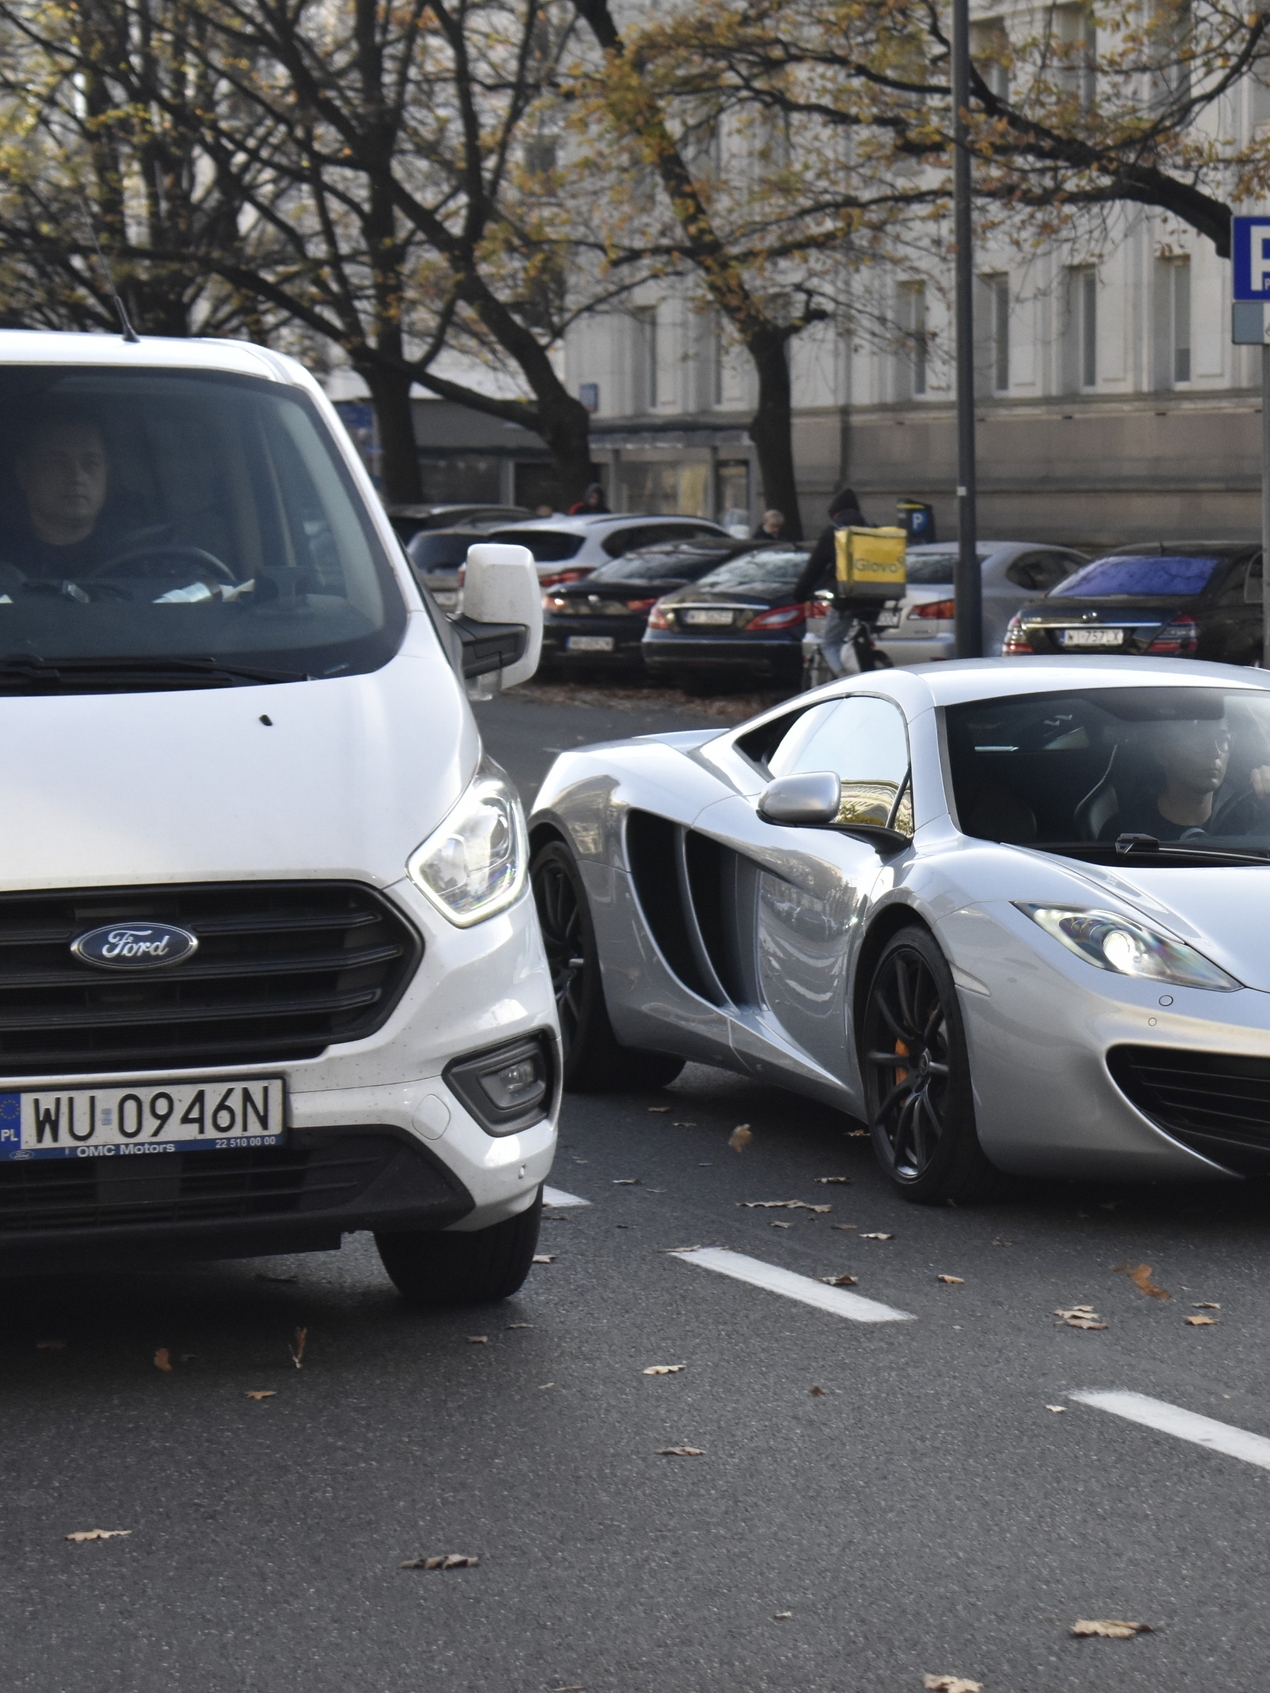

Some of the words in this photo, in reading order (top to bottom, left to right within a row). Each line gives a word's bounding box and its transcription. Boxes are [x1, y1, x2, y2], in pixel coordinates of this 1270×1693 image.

[912, 512, 925, 530] P
[854, 558, 899, 573] Glovo
[102, 930, 170, 958] Ford
[32, 1095, 97, 1143] WU
[117, 1085, 270, 1139] 0946N
[1, 1129, 19, 1142] PL
[215, 1139, 228, 1149] 22
[230, 1137, 245, 1148] 510
[246, 1137, 261, 1147] 00
[263, 1136, 276, 1146] 00
[76, 1145, 117, 1158] OMC
[119, 1142, 176, 1156] Motors
